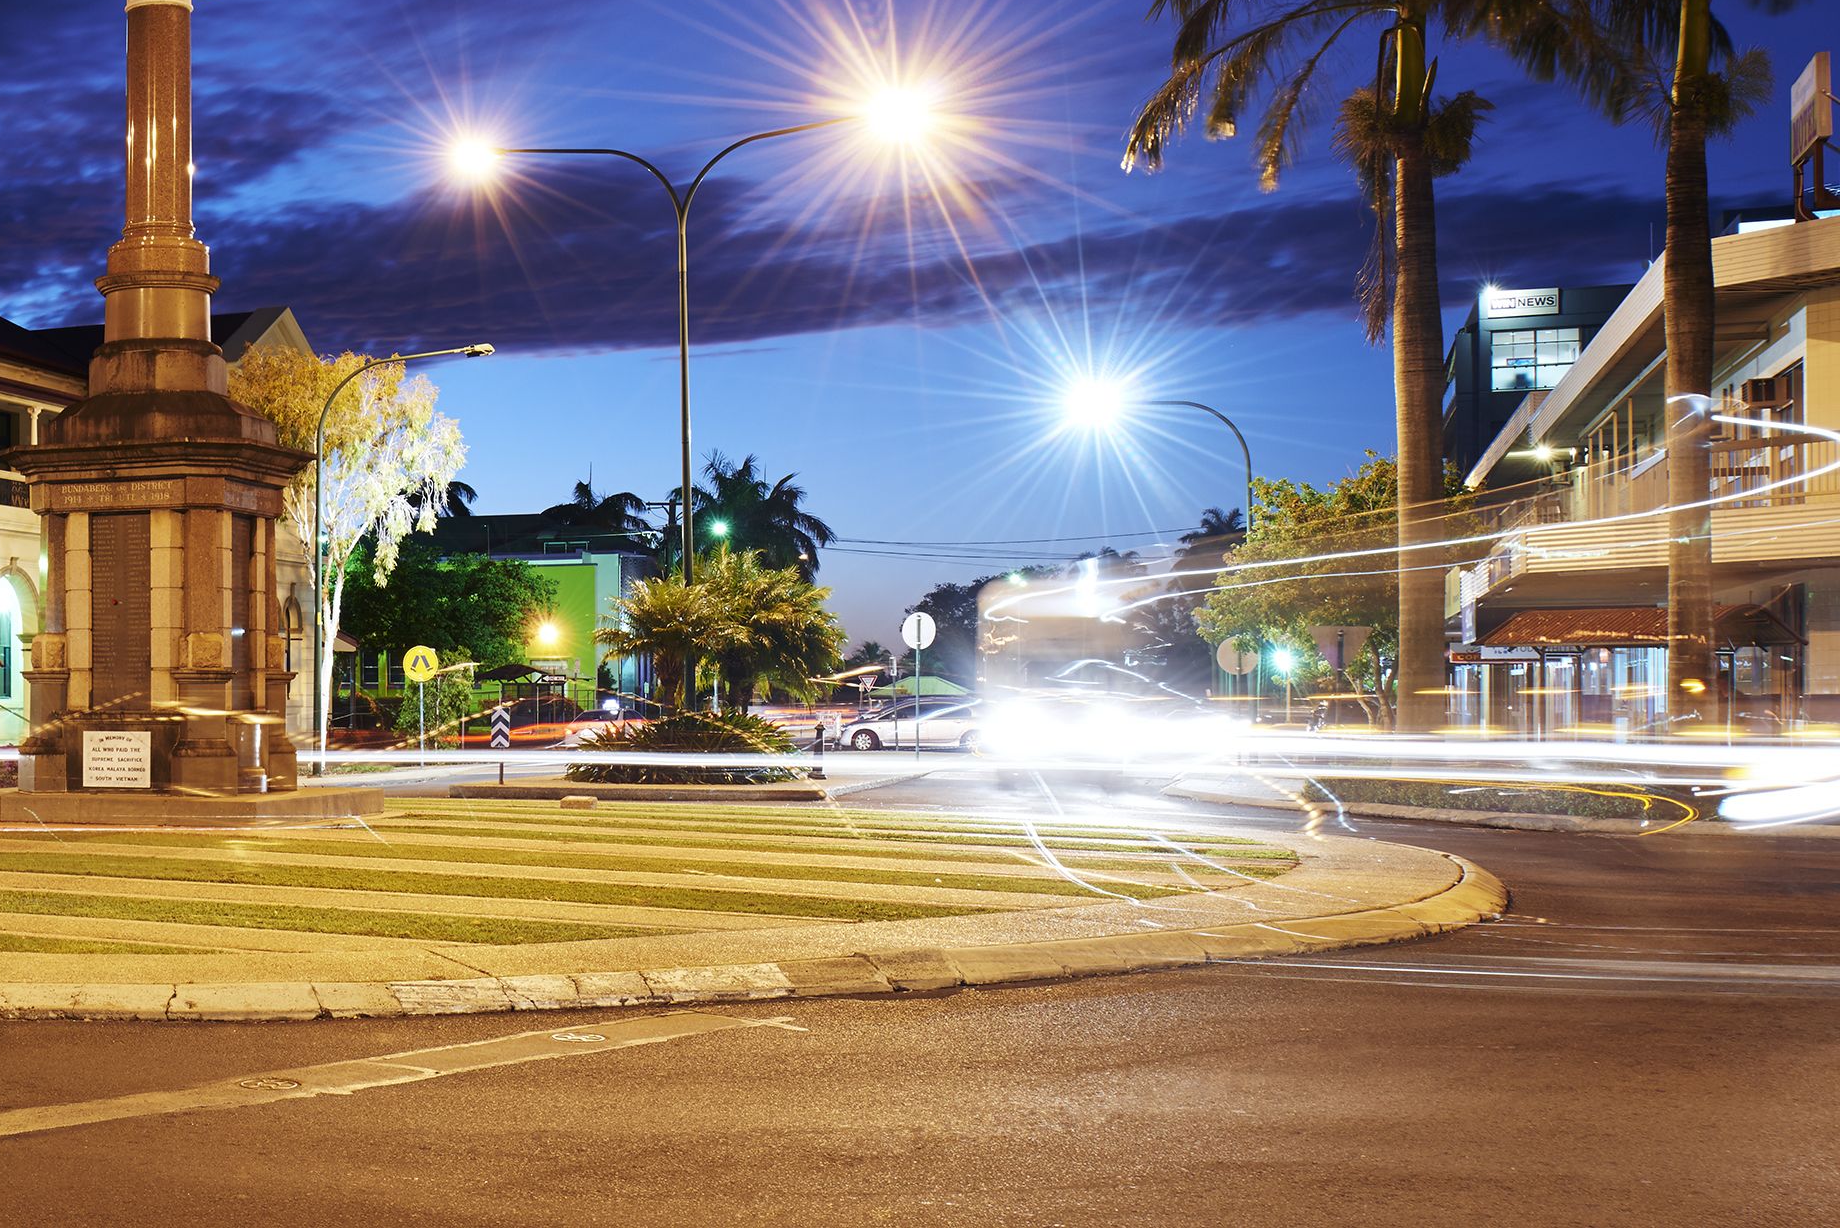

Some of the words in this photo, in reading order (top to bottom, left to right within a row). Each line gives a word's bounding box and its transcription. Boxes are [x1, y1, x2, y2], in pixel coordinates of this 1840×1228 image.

[1517, 296, 1555, 307] NEWS
[62, 483, 112, 493] BUNDABERG
[131, 481, 173, 492] DISTRICT
[151, 492, 170, 501] 1918
